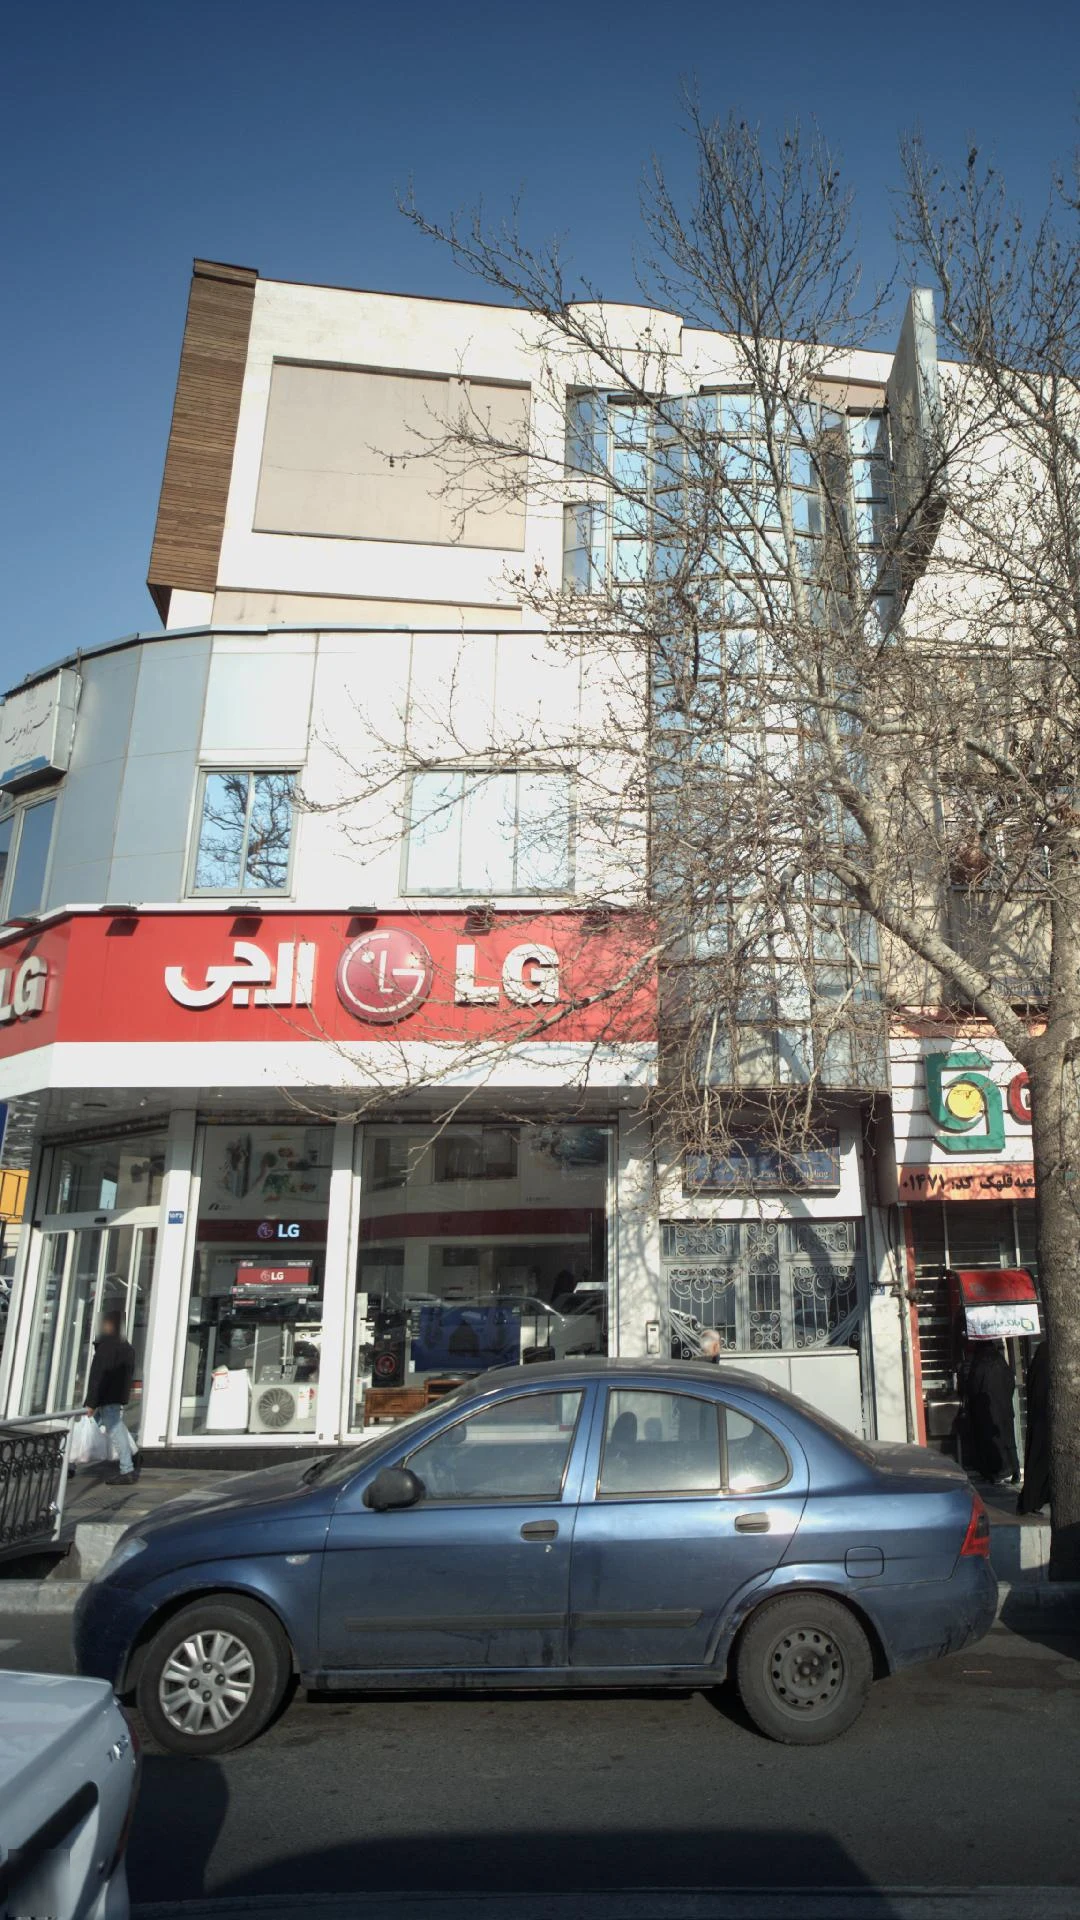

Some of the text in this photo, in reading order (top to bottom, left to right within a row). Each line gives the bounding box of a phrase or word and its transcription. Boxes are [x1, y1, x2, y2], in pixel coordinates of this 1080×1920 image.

[454, 943, 560, 1005] LG
[0, 955, 47, 1021] LG
[980, 1173, 1012, 1192] قلهک
[1014, 1175, 1037, 1193] عبه
[277, 1223, 300, 1238] LG
[271, 1271, 284, 1281] LG
